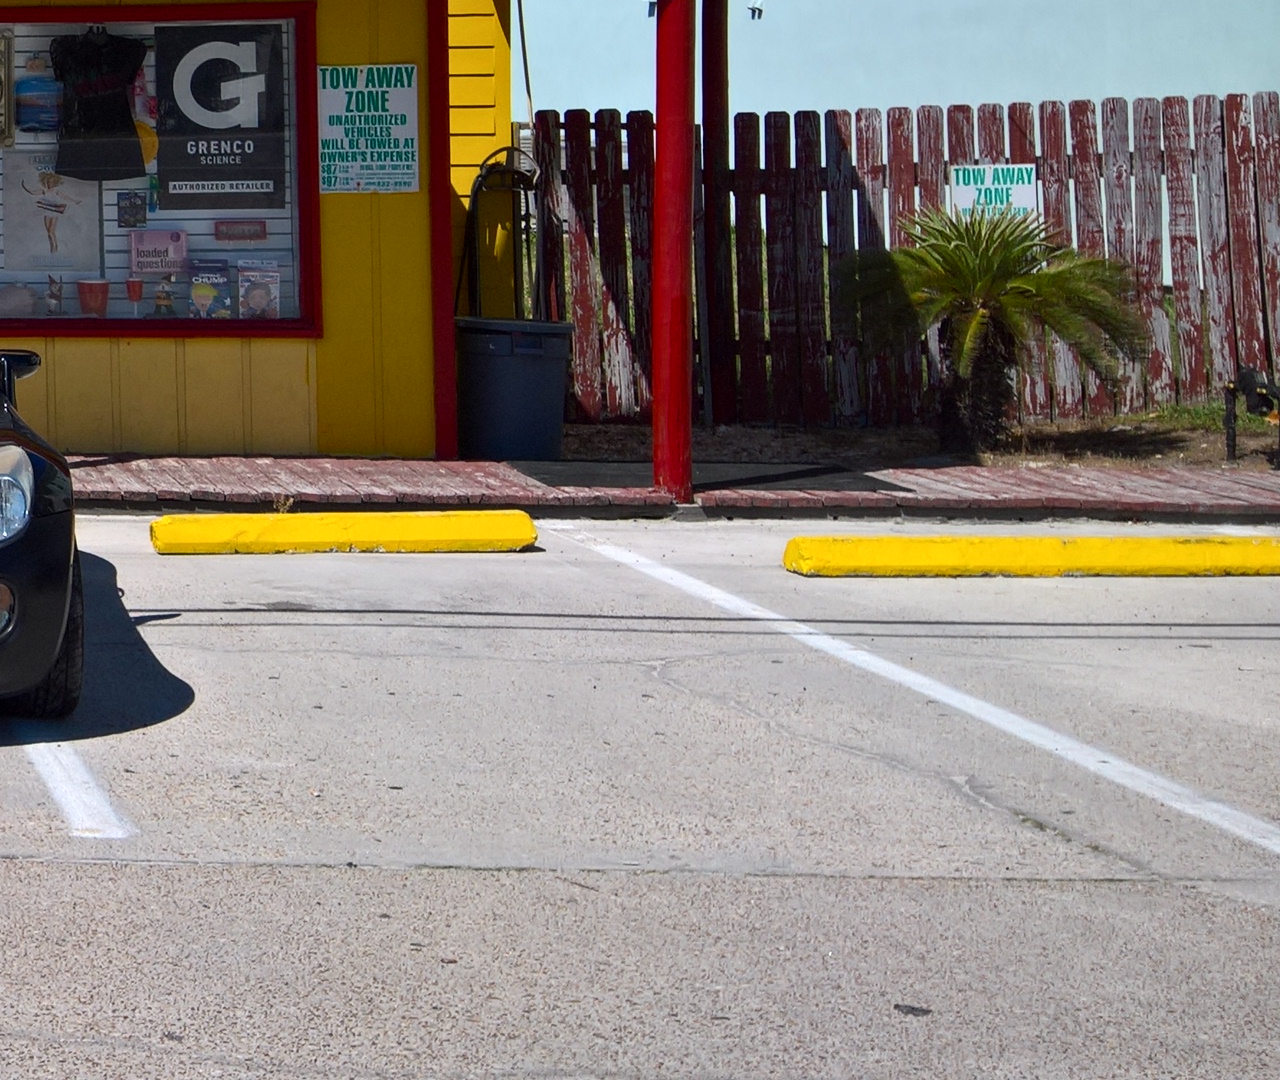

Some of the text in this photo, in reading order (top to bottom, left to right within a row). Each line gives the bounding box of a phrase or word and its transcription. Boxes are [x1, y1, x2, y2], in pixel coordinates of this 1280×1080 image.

[320, 66, 415, 89] TOW AWAY
[173, 41, 265, 129] G
[345, 90, 389, 113] ZONE
[328, 114, 407, 126] UNAUTHORIZED
[344, 126, 391, 138] VEHICLES
[187, 140, 254, 155] GRENCO
[321, 138, 415, 150] WILL BE TOWED AT
[201, 156, 241, 164] SCIENCE
[320, 150, 416, 163] OWNER'S EXPENSE
[954, 167, 1034, 186] TOW AWAY
[172, 182, 271, 191] AUTHORIZED RETAILER
[976, 187, 1012, 206] ZONE
[136, 247, 169, 258] loaded
[136, 259, 184, 272] questions
